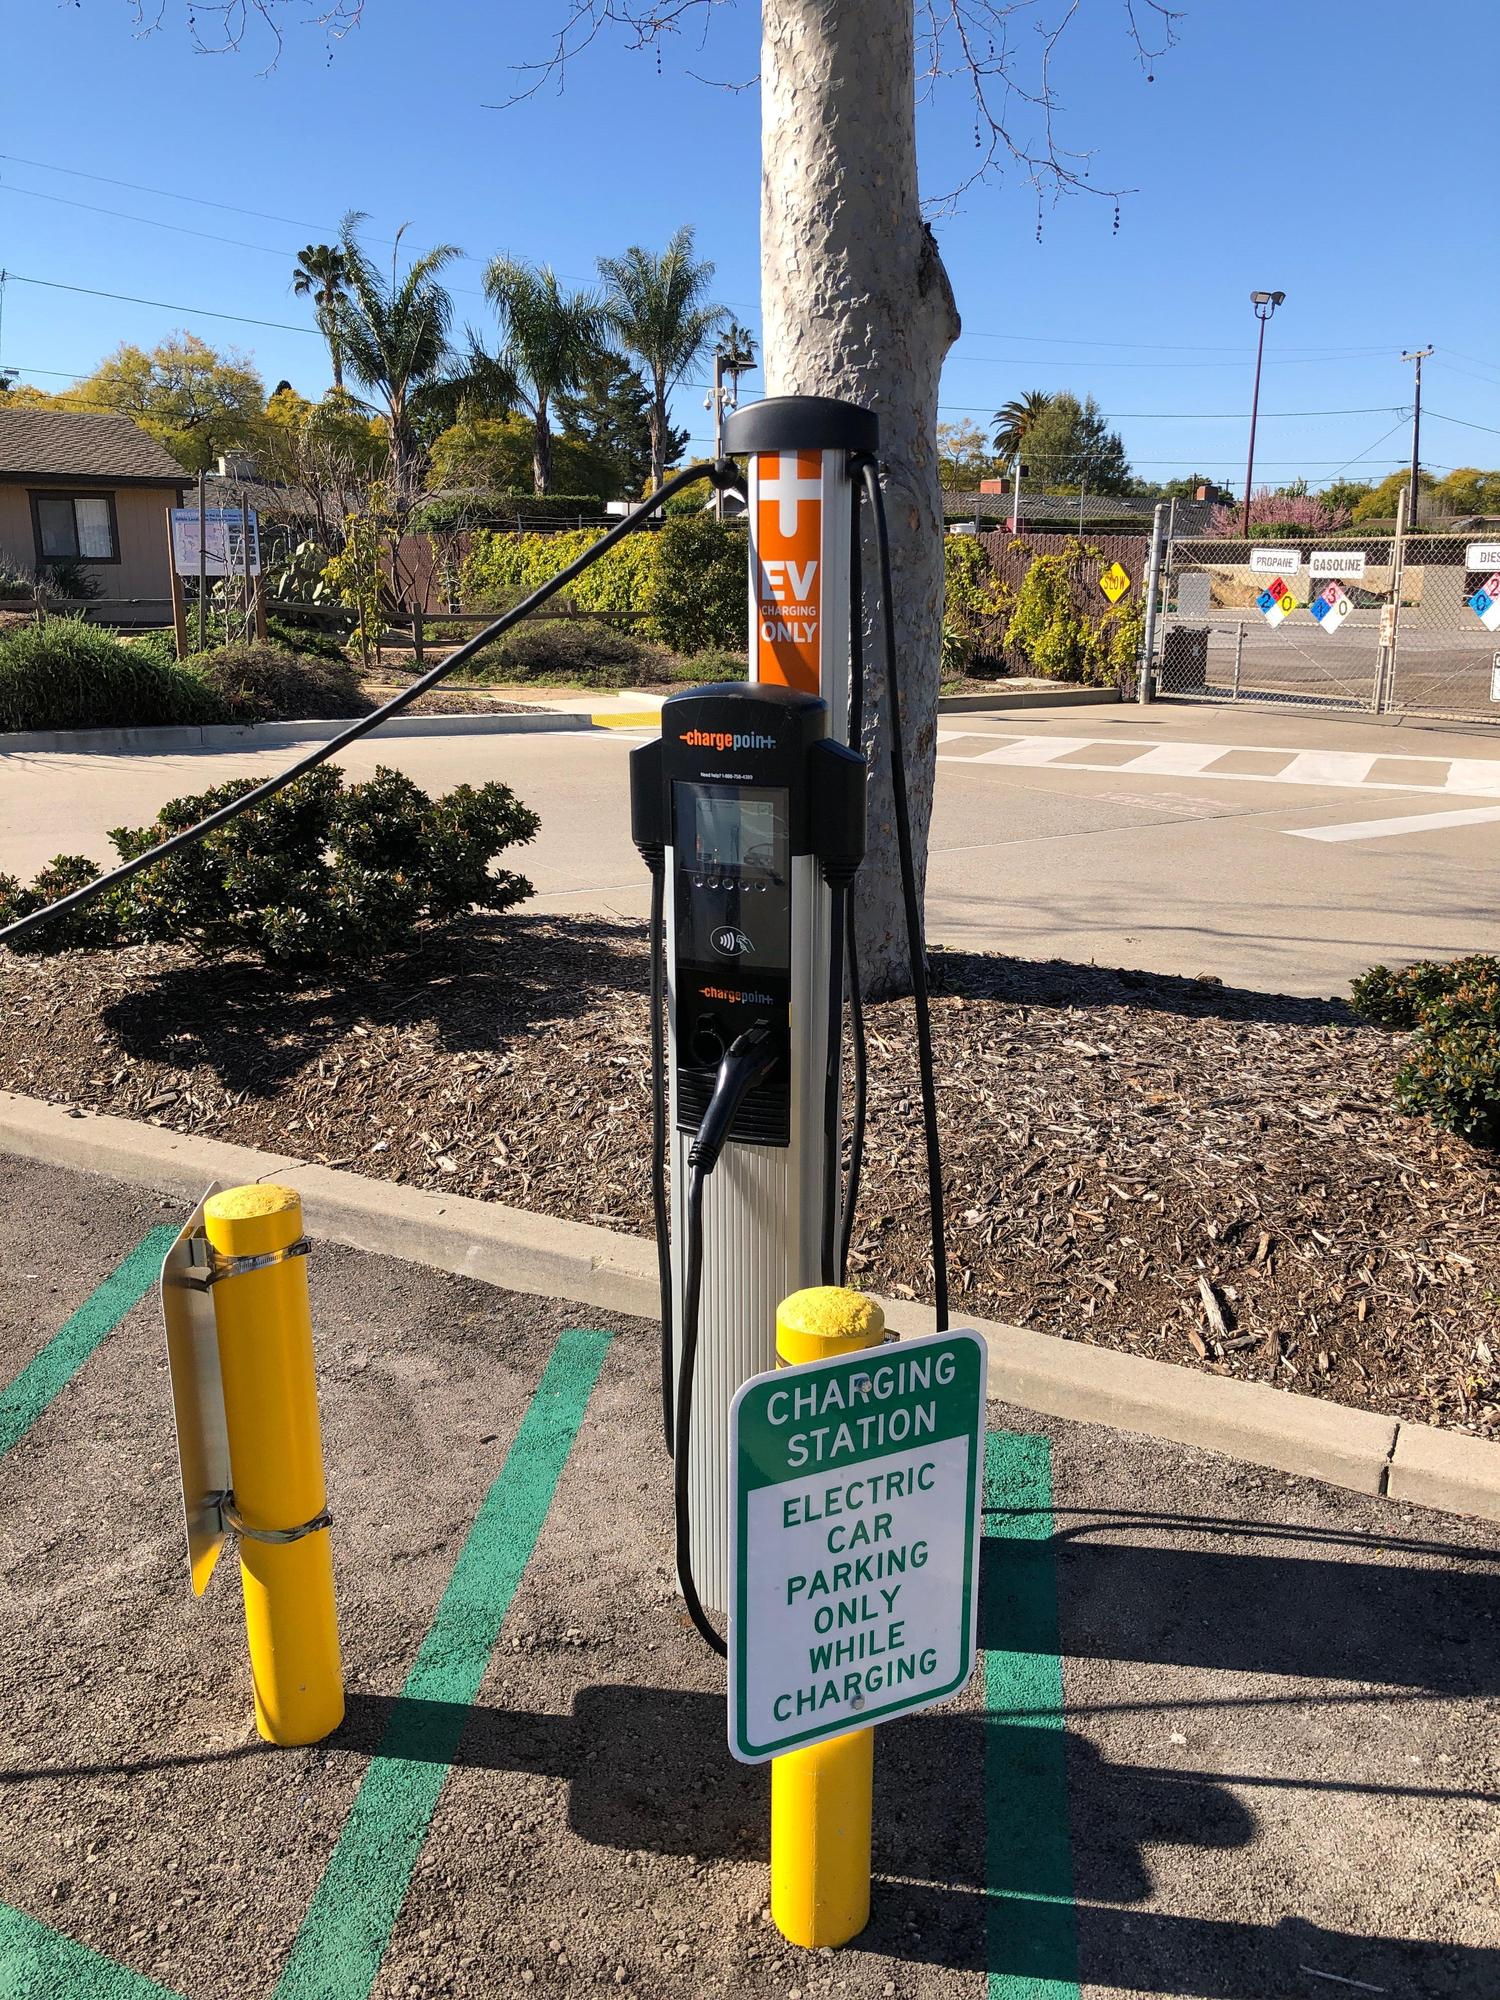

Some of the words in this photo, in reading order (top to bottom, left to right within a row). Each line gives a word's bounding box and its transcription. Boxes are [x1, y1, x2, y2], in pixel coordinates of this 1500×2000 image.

[1256, 556, 1294, 568] PROPANE
[1313, 558, 1362, 571] GASOLINE
[762, 560, 818, 600] EV
[1104, 575, 1126, 590] SLOW
[1273, 582, 1282, 595] 4
[1489, 578, 1499, 596] 2
[1260, 592, 1271, 608] 2
[1282, 595, 1292, 611] 0
[1327, 587, 1336, 604] 3
[1476, 595, 1486, 611] 0
[761, 604, 816, 617] CHARGING
[1338, 600, 1348, 616] 0
[761, 620, 818, 643] ONLY
[680, 729, 776, 751] chargepoint
[699, 985, 774, 1005] chargepoint
[766, 1351, 956, 1426] CHARGING
[787, 1400, 936, 1468] STATION
[782, 1462, 936, 1529] ELECTRIC
[826, 1512, 893, 1554] CAR
[786, 1540, 929, 1606] PARKING
[814, 1584, 902, 1635] ONLY
[809, 1621, 905, 1674] WHILE
[773, 1648, 938, 1722] CHARGING
